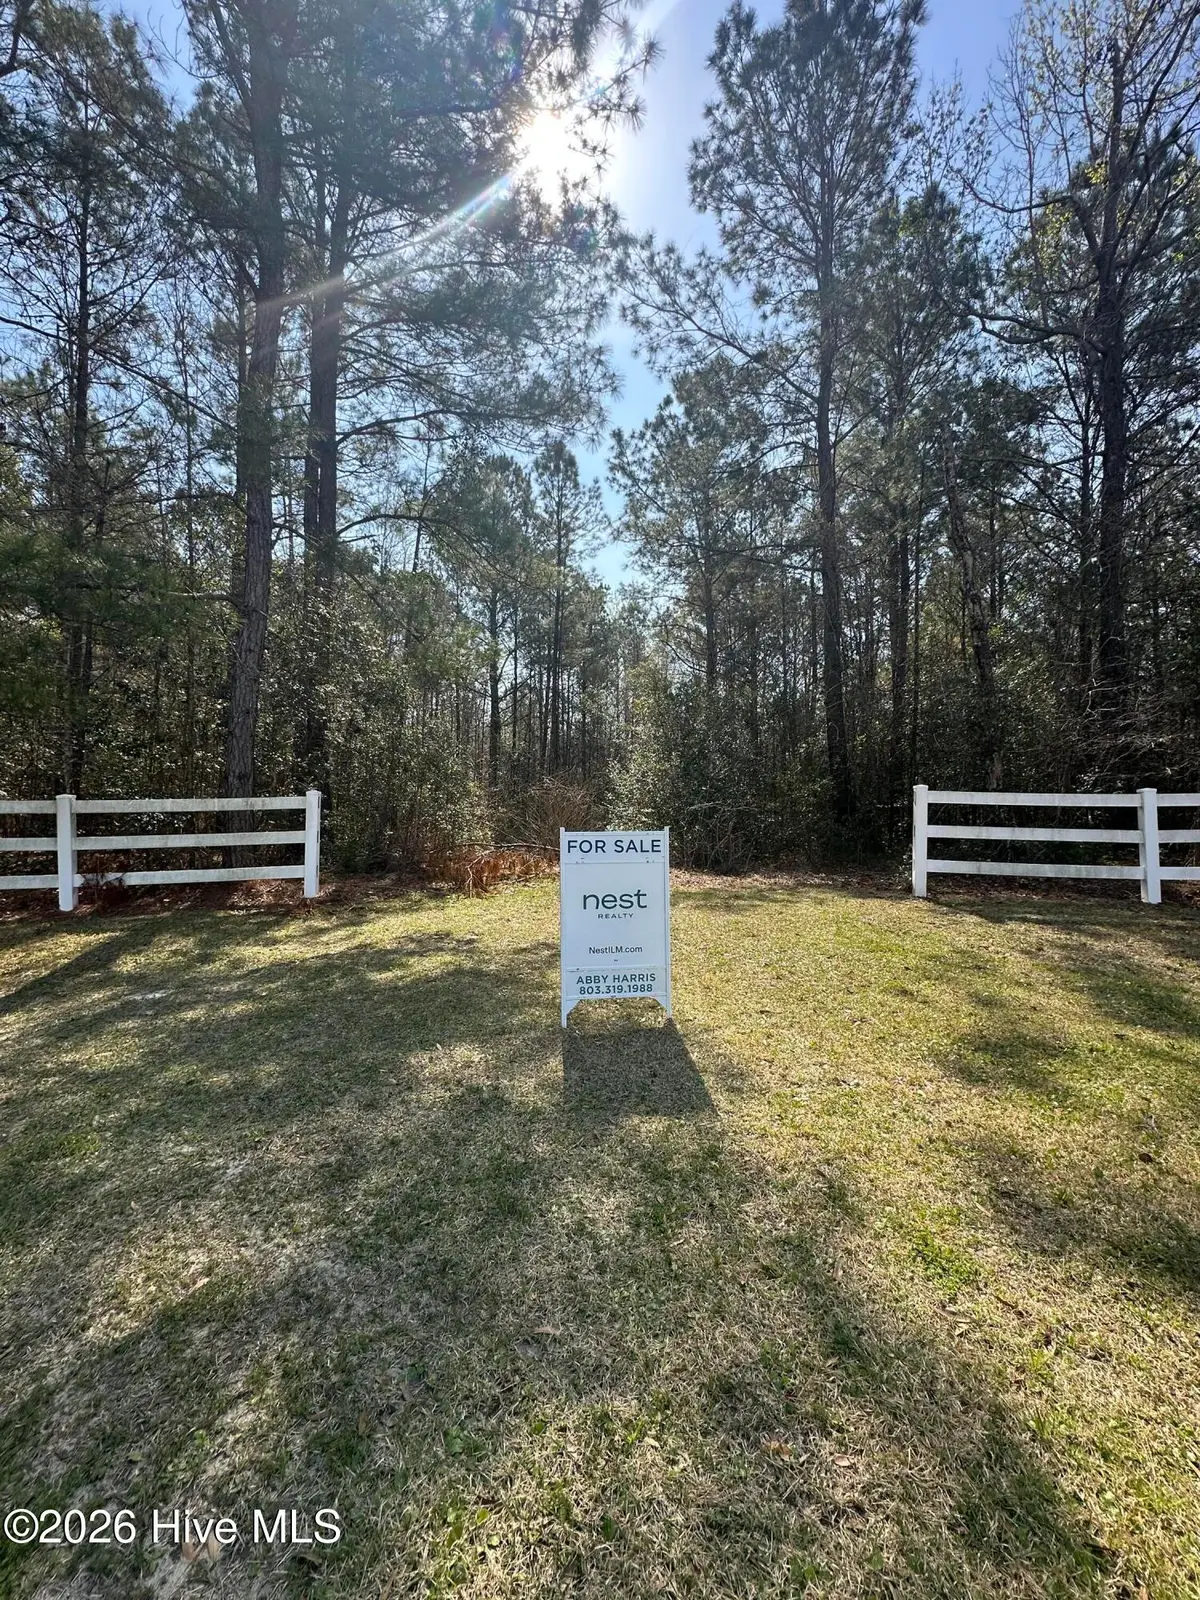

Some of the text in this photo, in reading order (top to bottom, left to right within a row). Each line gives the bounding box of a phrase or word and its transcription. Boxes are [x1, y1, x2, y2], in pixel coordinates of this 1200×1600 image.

[567, 839, 662, 853] FOR SALE
[583, 889, 648, 910] nest
[588, 945, 643, 954] NestILM.com
[576, 973, 656, 984] ABBY HARRIS
[579, 984, 653, 995] 803.319.1988
